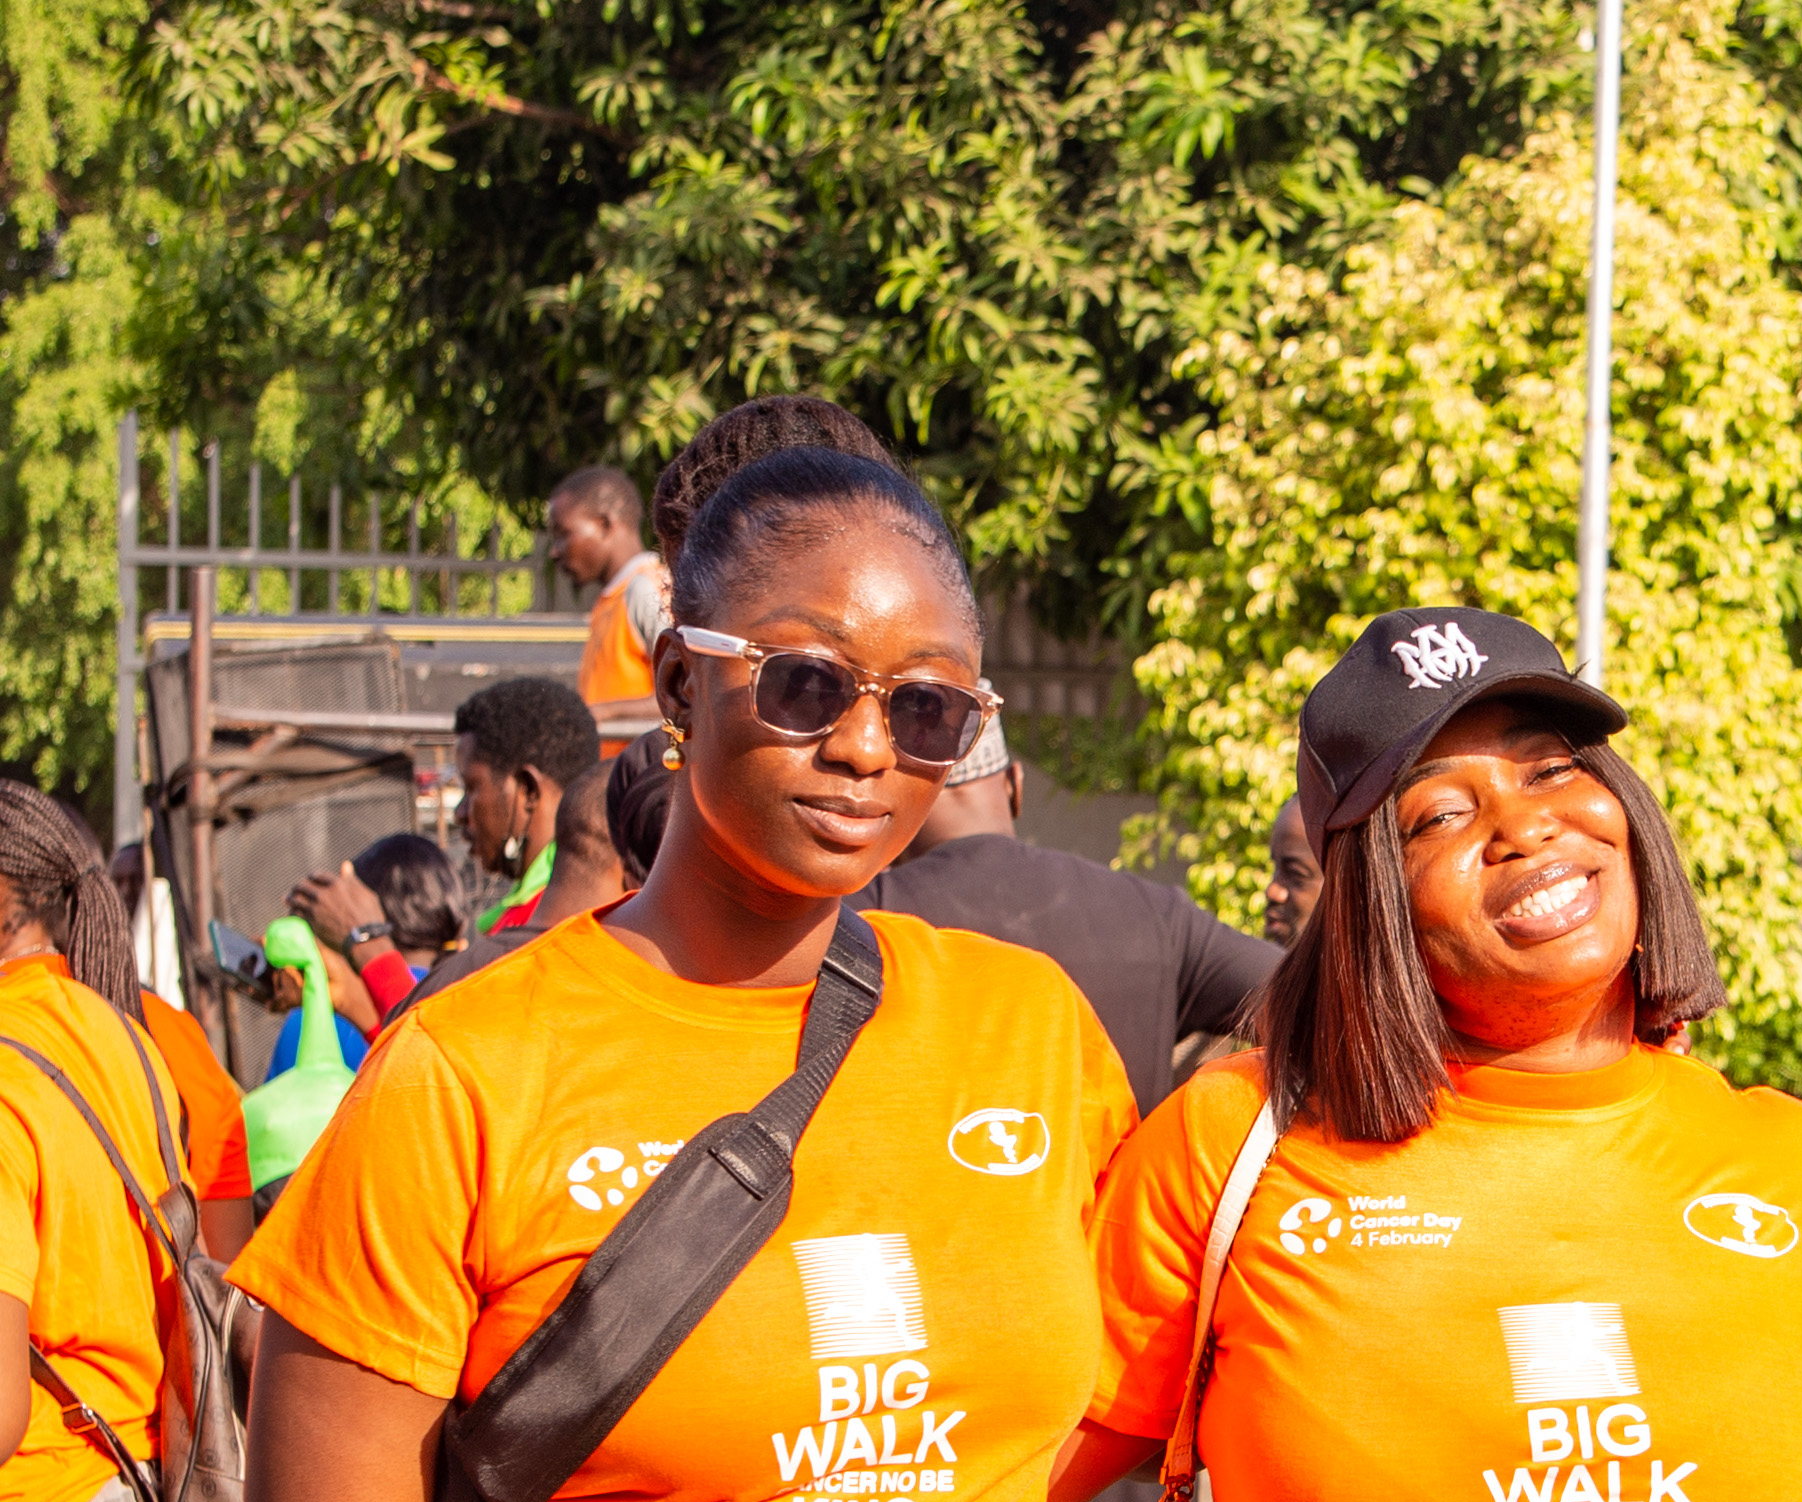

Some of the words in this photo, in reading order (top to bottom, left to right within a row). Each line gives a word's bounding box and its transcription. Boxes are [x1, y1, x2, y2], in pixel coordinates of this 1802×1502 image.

[1348, 1195, 1406, 1212] World
[1350, 1215, 1420, 1230] Cancer
[1423, 1213, 1462, 1232] Day
[1351, 1233, 1364, 1247] 4
[1369, 1231, 1453, 1248] February
[817, 1359, 930, 1422] BIG
[1527, 1403, 1651, 1462] BIG
[772, 1410, 967, 1481] WALK
[880, 1471, 917, 1492] NO
[919, 1470, 955, 1492] BE
